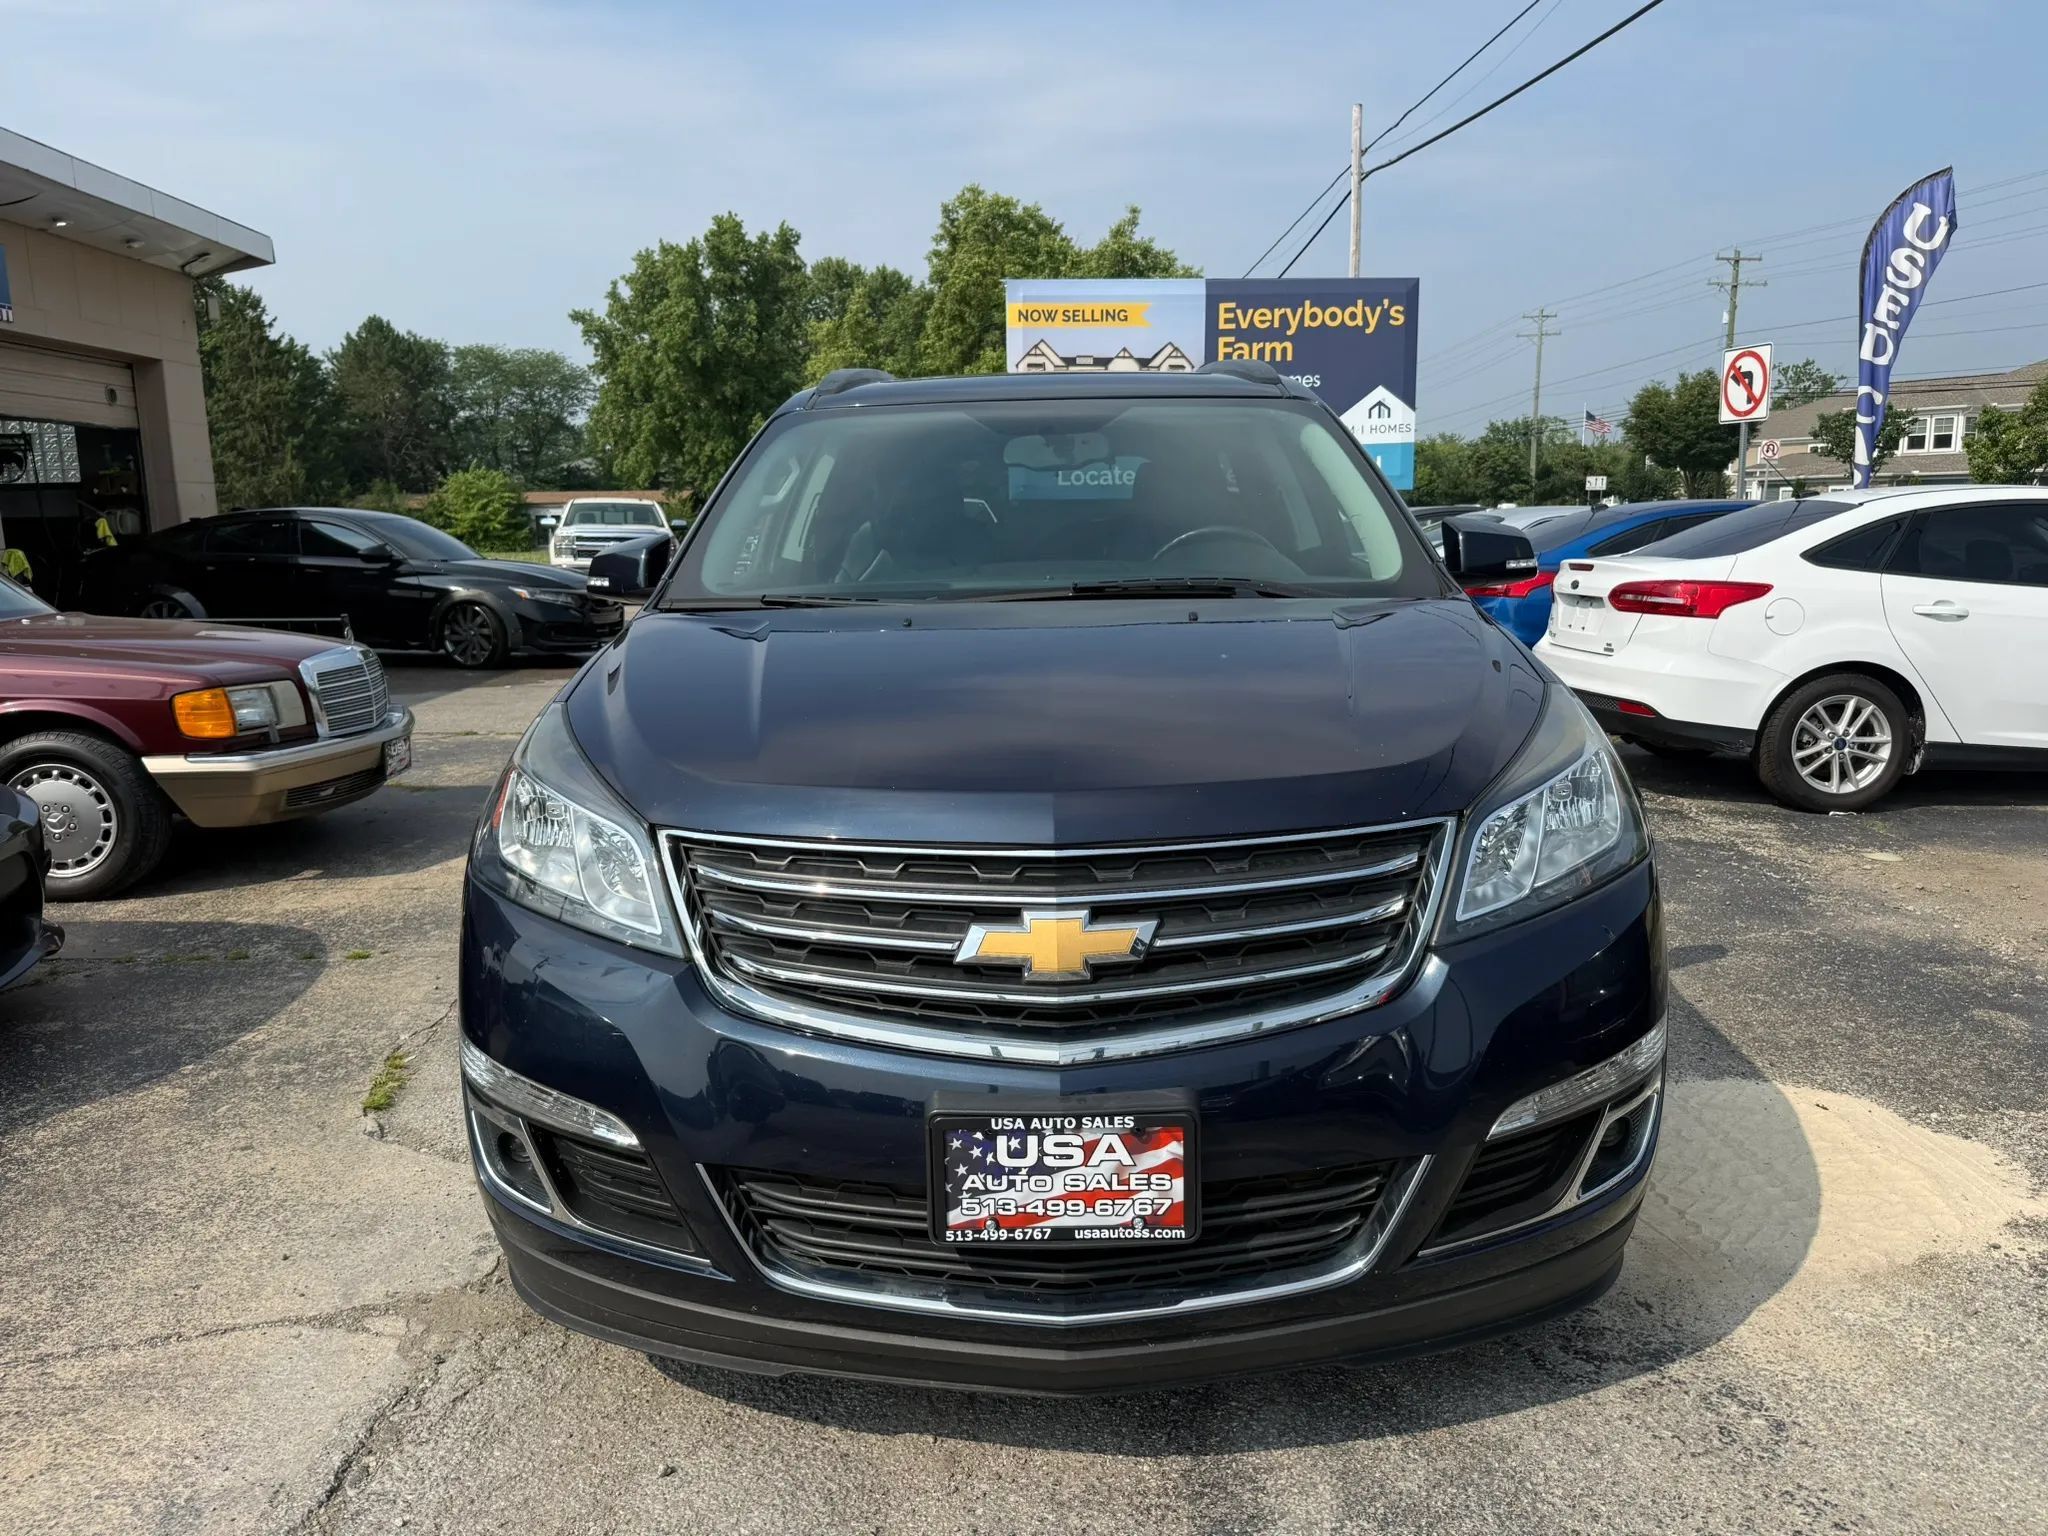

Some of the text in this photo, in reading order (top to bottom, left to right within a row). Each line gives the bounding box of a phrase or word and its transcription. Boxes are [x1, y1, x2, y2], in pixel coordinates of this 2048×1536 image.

[1860, 202, 1950, 366] USED
[1018, 308, 1128, 322] NOW SELLING
[1218, 299, 1405, 336] Everybody's
[1217, 335, 1293, 362] Farm
[1369, 423, 1412, 434] HOMES
[1057, 466, 1136, 486] Locate
[990, 1116, 1135, 1130] USA AUTO SALES
[996, 1133, 1136, 1168] USA
[961, 1173, 1173, 1192] AUTO SALES
[960, 1198, 1173, 1217] 513-499-6767
[945, 1228, 1052, 1242] 513-499-6767
[1074, 1227, 1186, 1239] usaautoss.com
